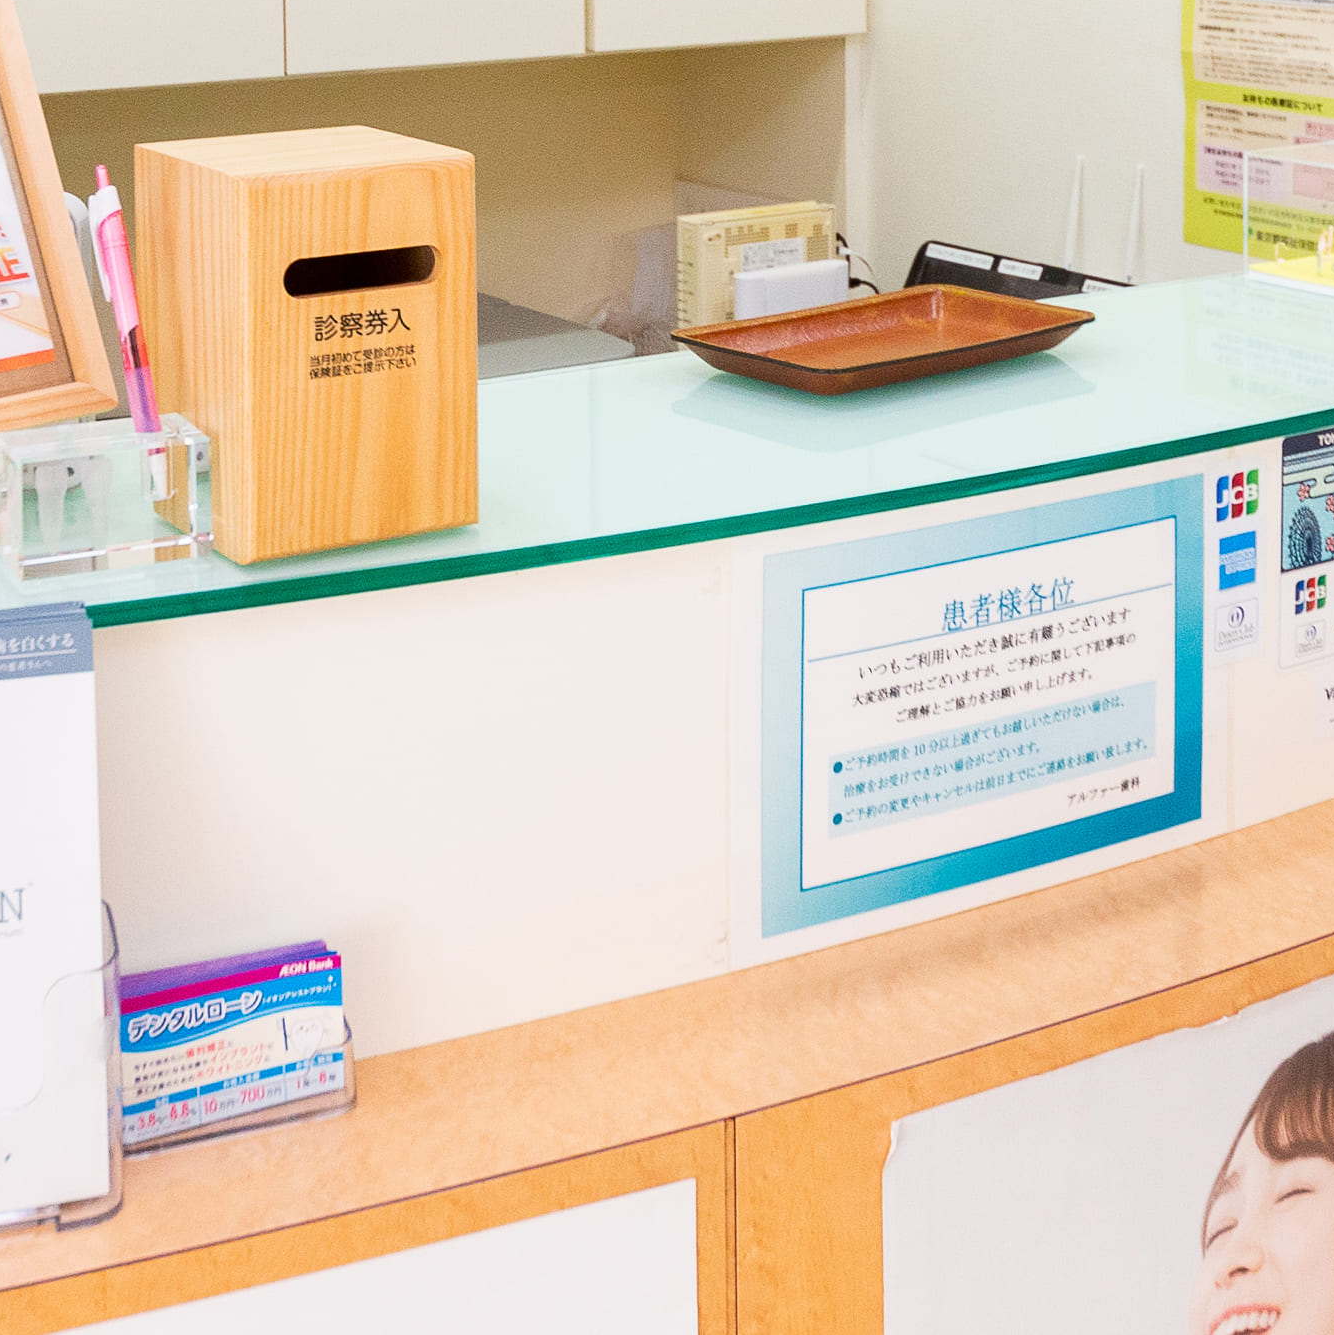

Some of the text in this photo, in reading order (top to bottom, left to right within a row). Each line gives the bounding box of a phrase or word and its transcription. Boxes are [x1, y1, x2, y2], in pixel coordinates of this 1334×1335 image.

[313, 308, 412, 342] 診察券入
[309, 344, 416, 368] 当月初めて受診の方は
[309, 356, 417, 381] 保険証をご提示下さい
[1216, 468, 1259, 523] JCB
[941, 576, 1075, 633] 患者様各位
[1294, 574, 1327, 615] JCB
[843, 740, 1041, 799] 治療をお受けできない場合がございます。
[1066, 776, 1141, 806] アルファー歯科
[309, 958, 334, 972] Bank
[127, 989, 263, 1044] デンタルローン
